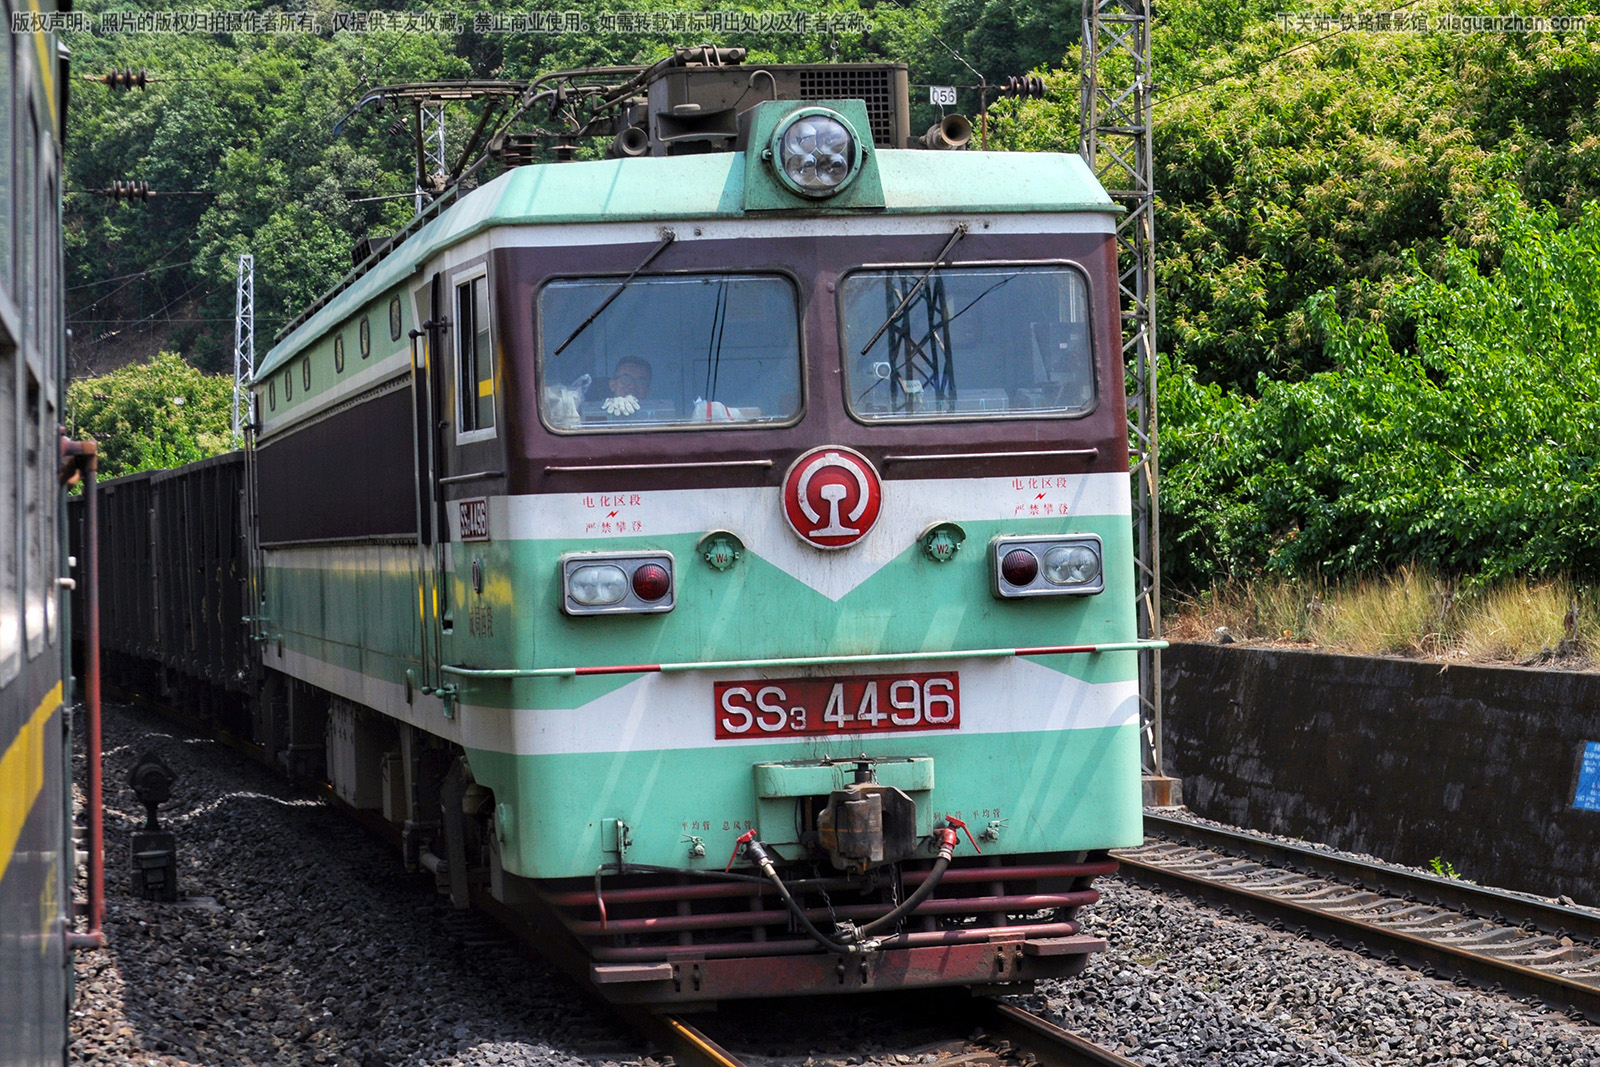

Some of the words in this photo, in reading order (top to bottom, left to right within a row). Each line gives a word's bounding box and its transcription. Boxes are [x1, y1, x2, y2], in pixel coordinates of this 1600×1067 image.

[932, 90, 955, 103] 056
[1012, 477, 1067, 490] 电化区段
[583, 494, 641, 508] 电化区段
[1015, 503, 1069, 515] 严禁攀登
[586, 521, 642, 534] 严禁攀登
[936, 543, 949, 554] W2
[715, 553, 728, 563] W4
[721, 686, 807, 734] SS3
[823, 678, 955, 729] 4496
[681, 820, 711, 831] 平均管
[722, 820, 752, 831] 总风管
